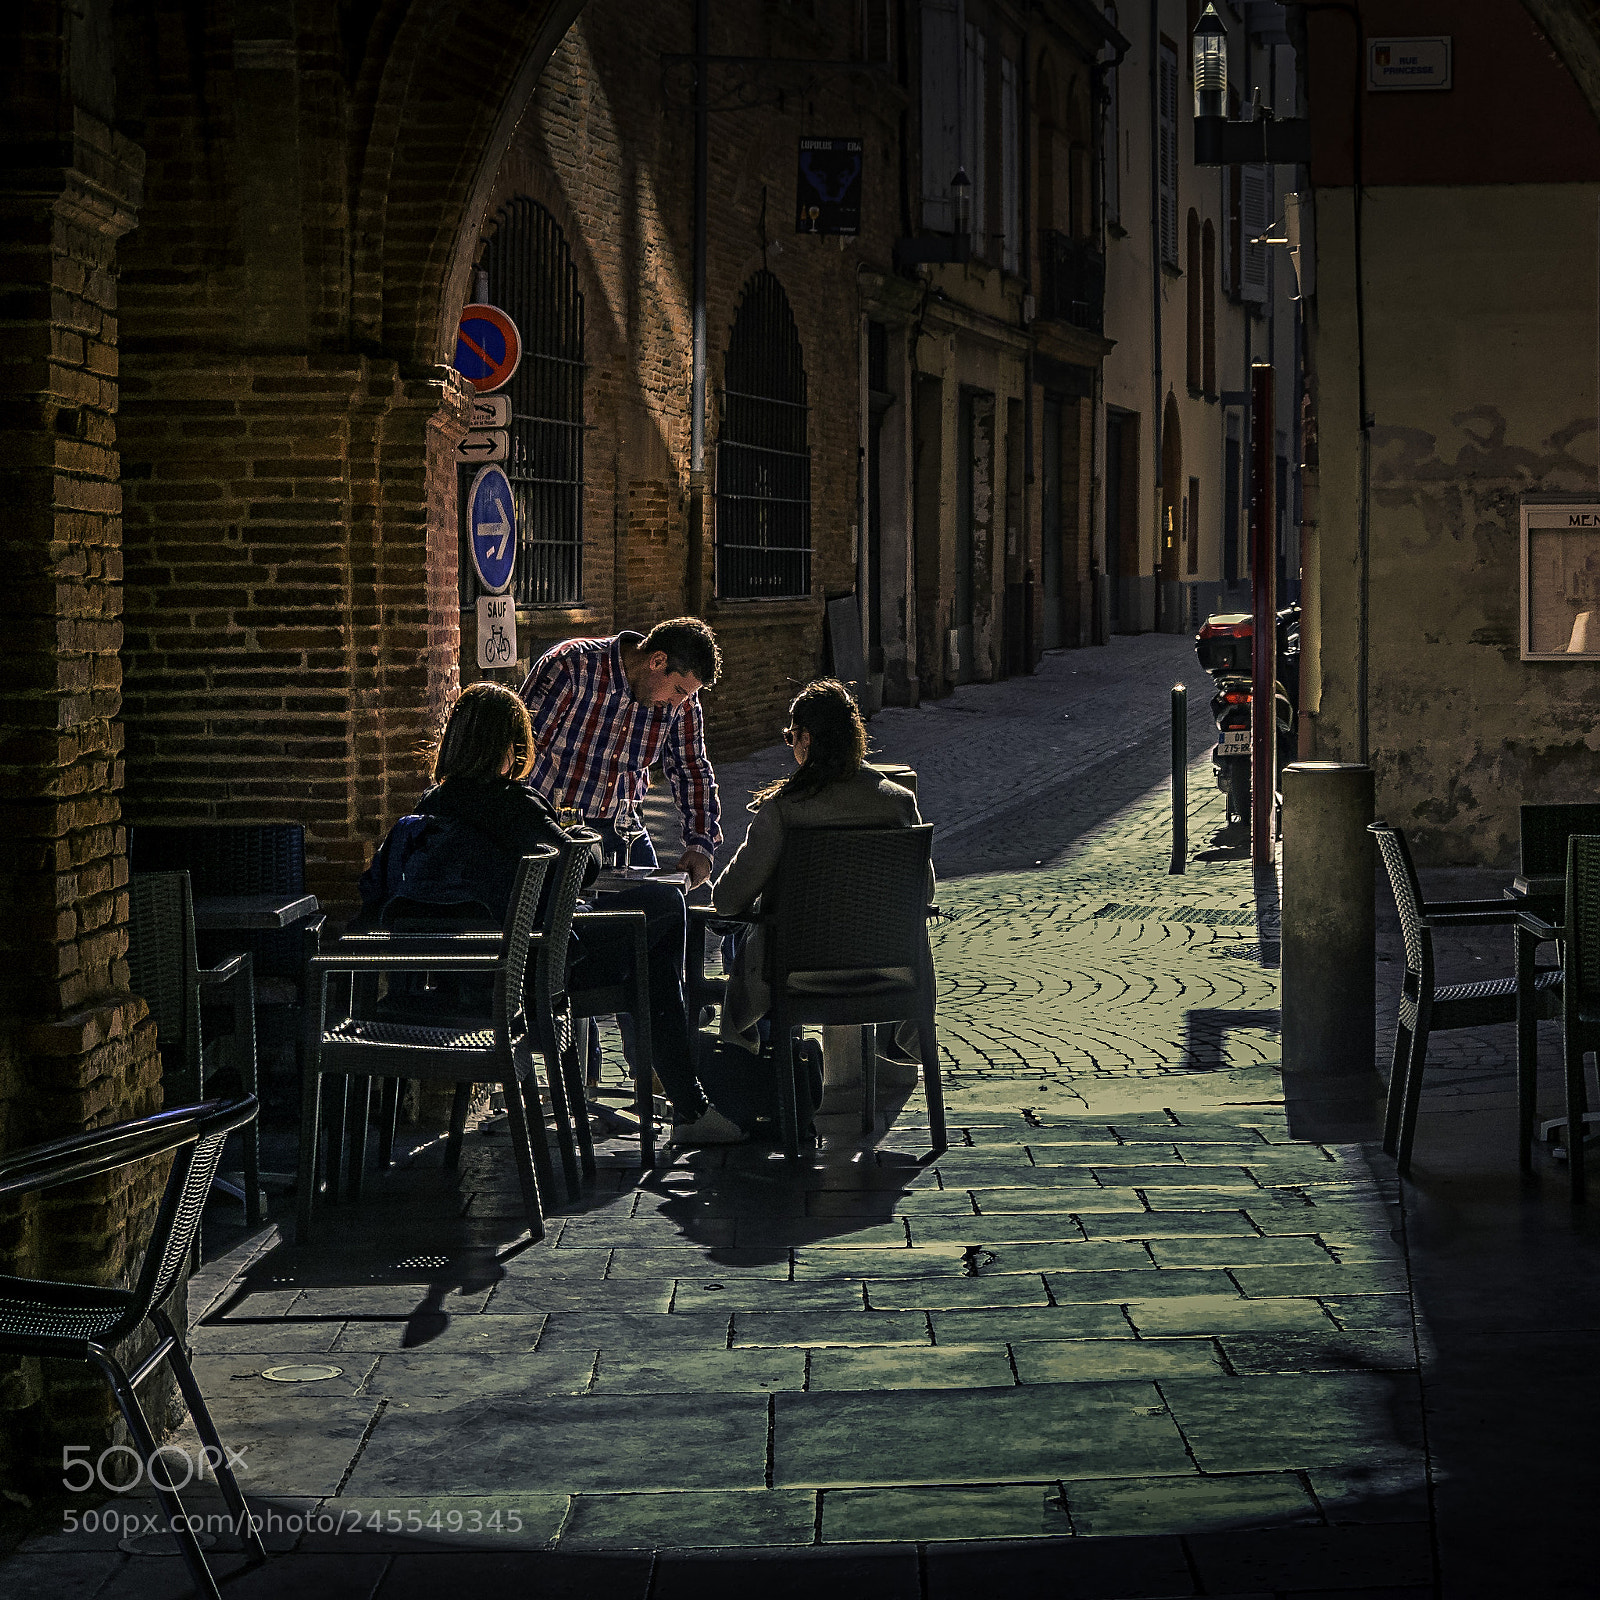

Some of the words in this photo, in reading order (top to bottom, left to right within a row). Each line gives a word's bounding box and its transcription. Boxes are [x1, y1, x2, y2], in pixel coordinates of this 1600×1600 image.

[1399, 56, 1418, 65] RUE
[1383, 66, 1434, 75] PRINCESSE
[487, 601, 507, 618] SAUF
